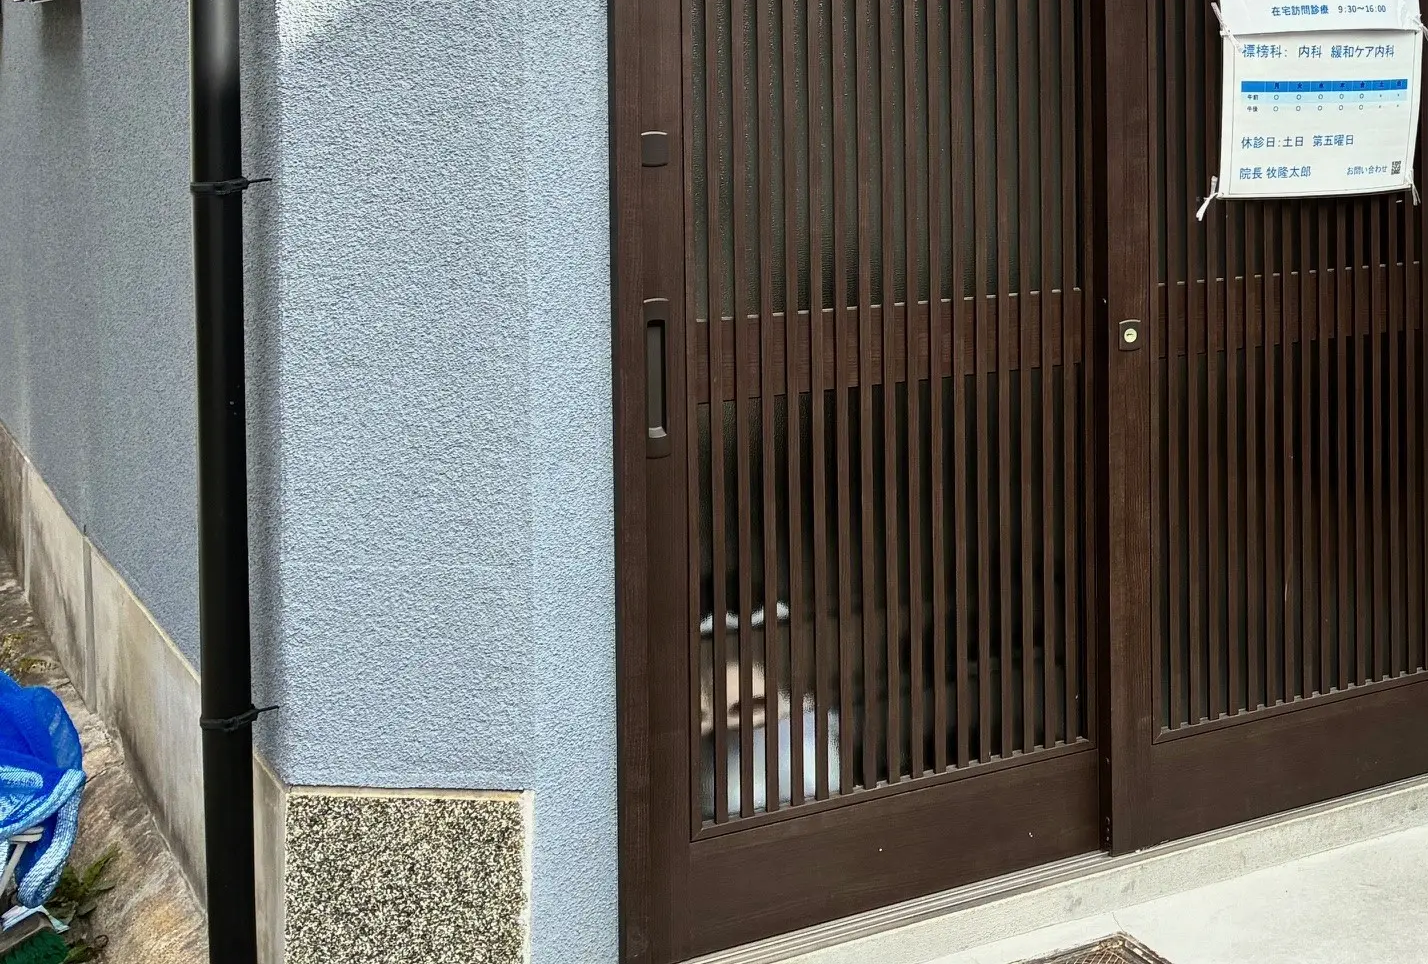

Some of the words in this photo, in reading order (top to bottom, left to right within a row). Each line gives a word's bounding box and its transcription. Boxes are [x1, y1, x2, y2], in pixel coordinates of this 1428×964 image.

[1271, 5, 1329, 16] 在宅訪問診療
[1298, 45, 1322, 58] 内科
[1331, 44, 1395, 58] 緩和ケア内科
[1239, 167, 1263, 180] 院長
[1346, 165, 1388, 176] お問い合わせ
